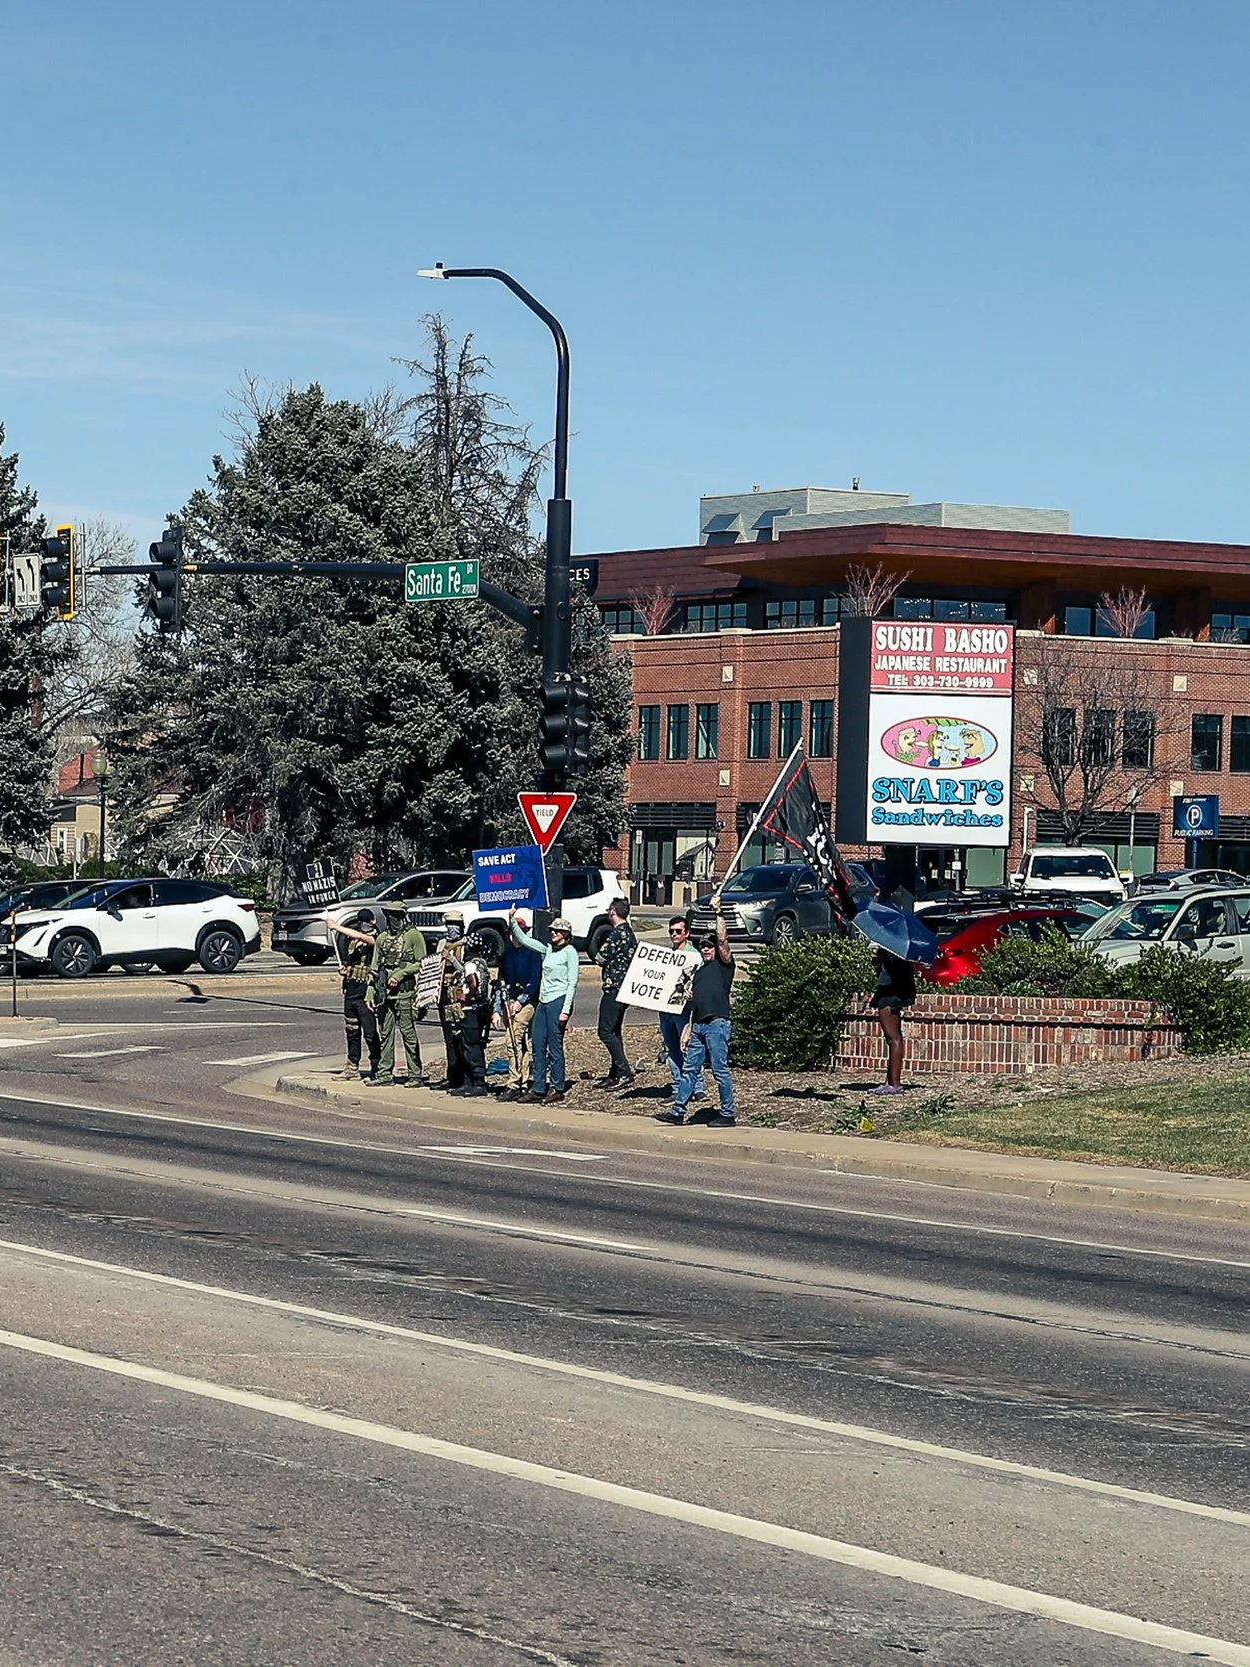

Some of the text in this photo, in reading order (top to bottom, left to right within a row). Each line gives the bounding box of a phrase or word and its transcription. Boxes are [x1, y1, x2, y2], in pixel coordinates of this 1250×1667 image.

[407, 563, 474, 596] Santa Fe DR
[875, 626, 1008, 654] SUSHI BASHO
[874, 655, 1008, 674] JAPANESE RESTAURANT
[913, 674, 994, 689] 303-730-9999
[872, 777, 1004, 806] SNARF'S
[535, 809, 554, 817] YIELD
[872, 806, 1004, 827] Sandwiches
[1191, 808, 1200, 825] P
[1174, 829, 1214, 837] PUBLIC PARKING
[478, 853, 516, 867] SAVE ACT
[302, 876, 336, 893] NO NAZIS
[489, 873, 512, 884] KILLS
[479, 888, 530, 903] DEMOCRACY
[637, 946, 686, 967] DEFEND
[642, 967, 666, 981] YOUR
[631, 981, 663, 1000] VOTE
